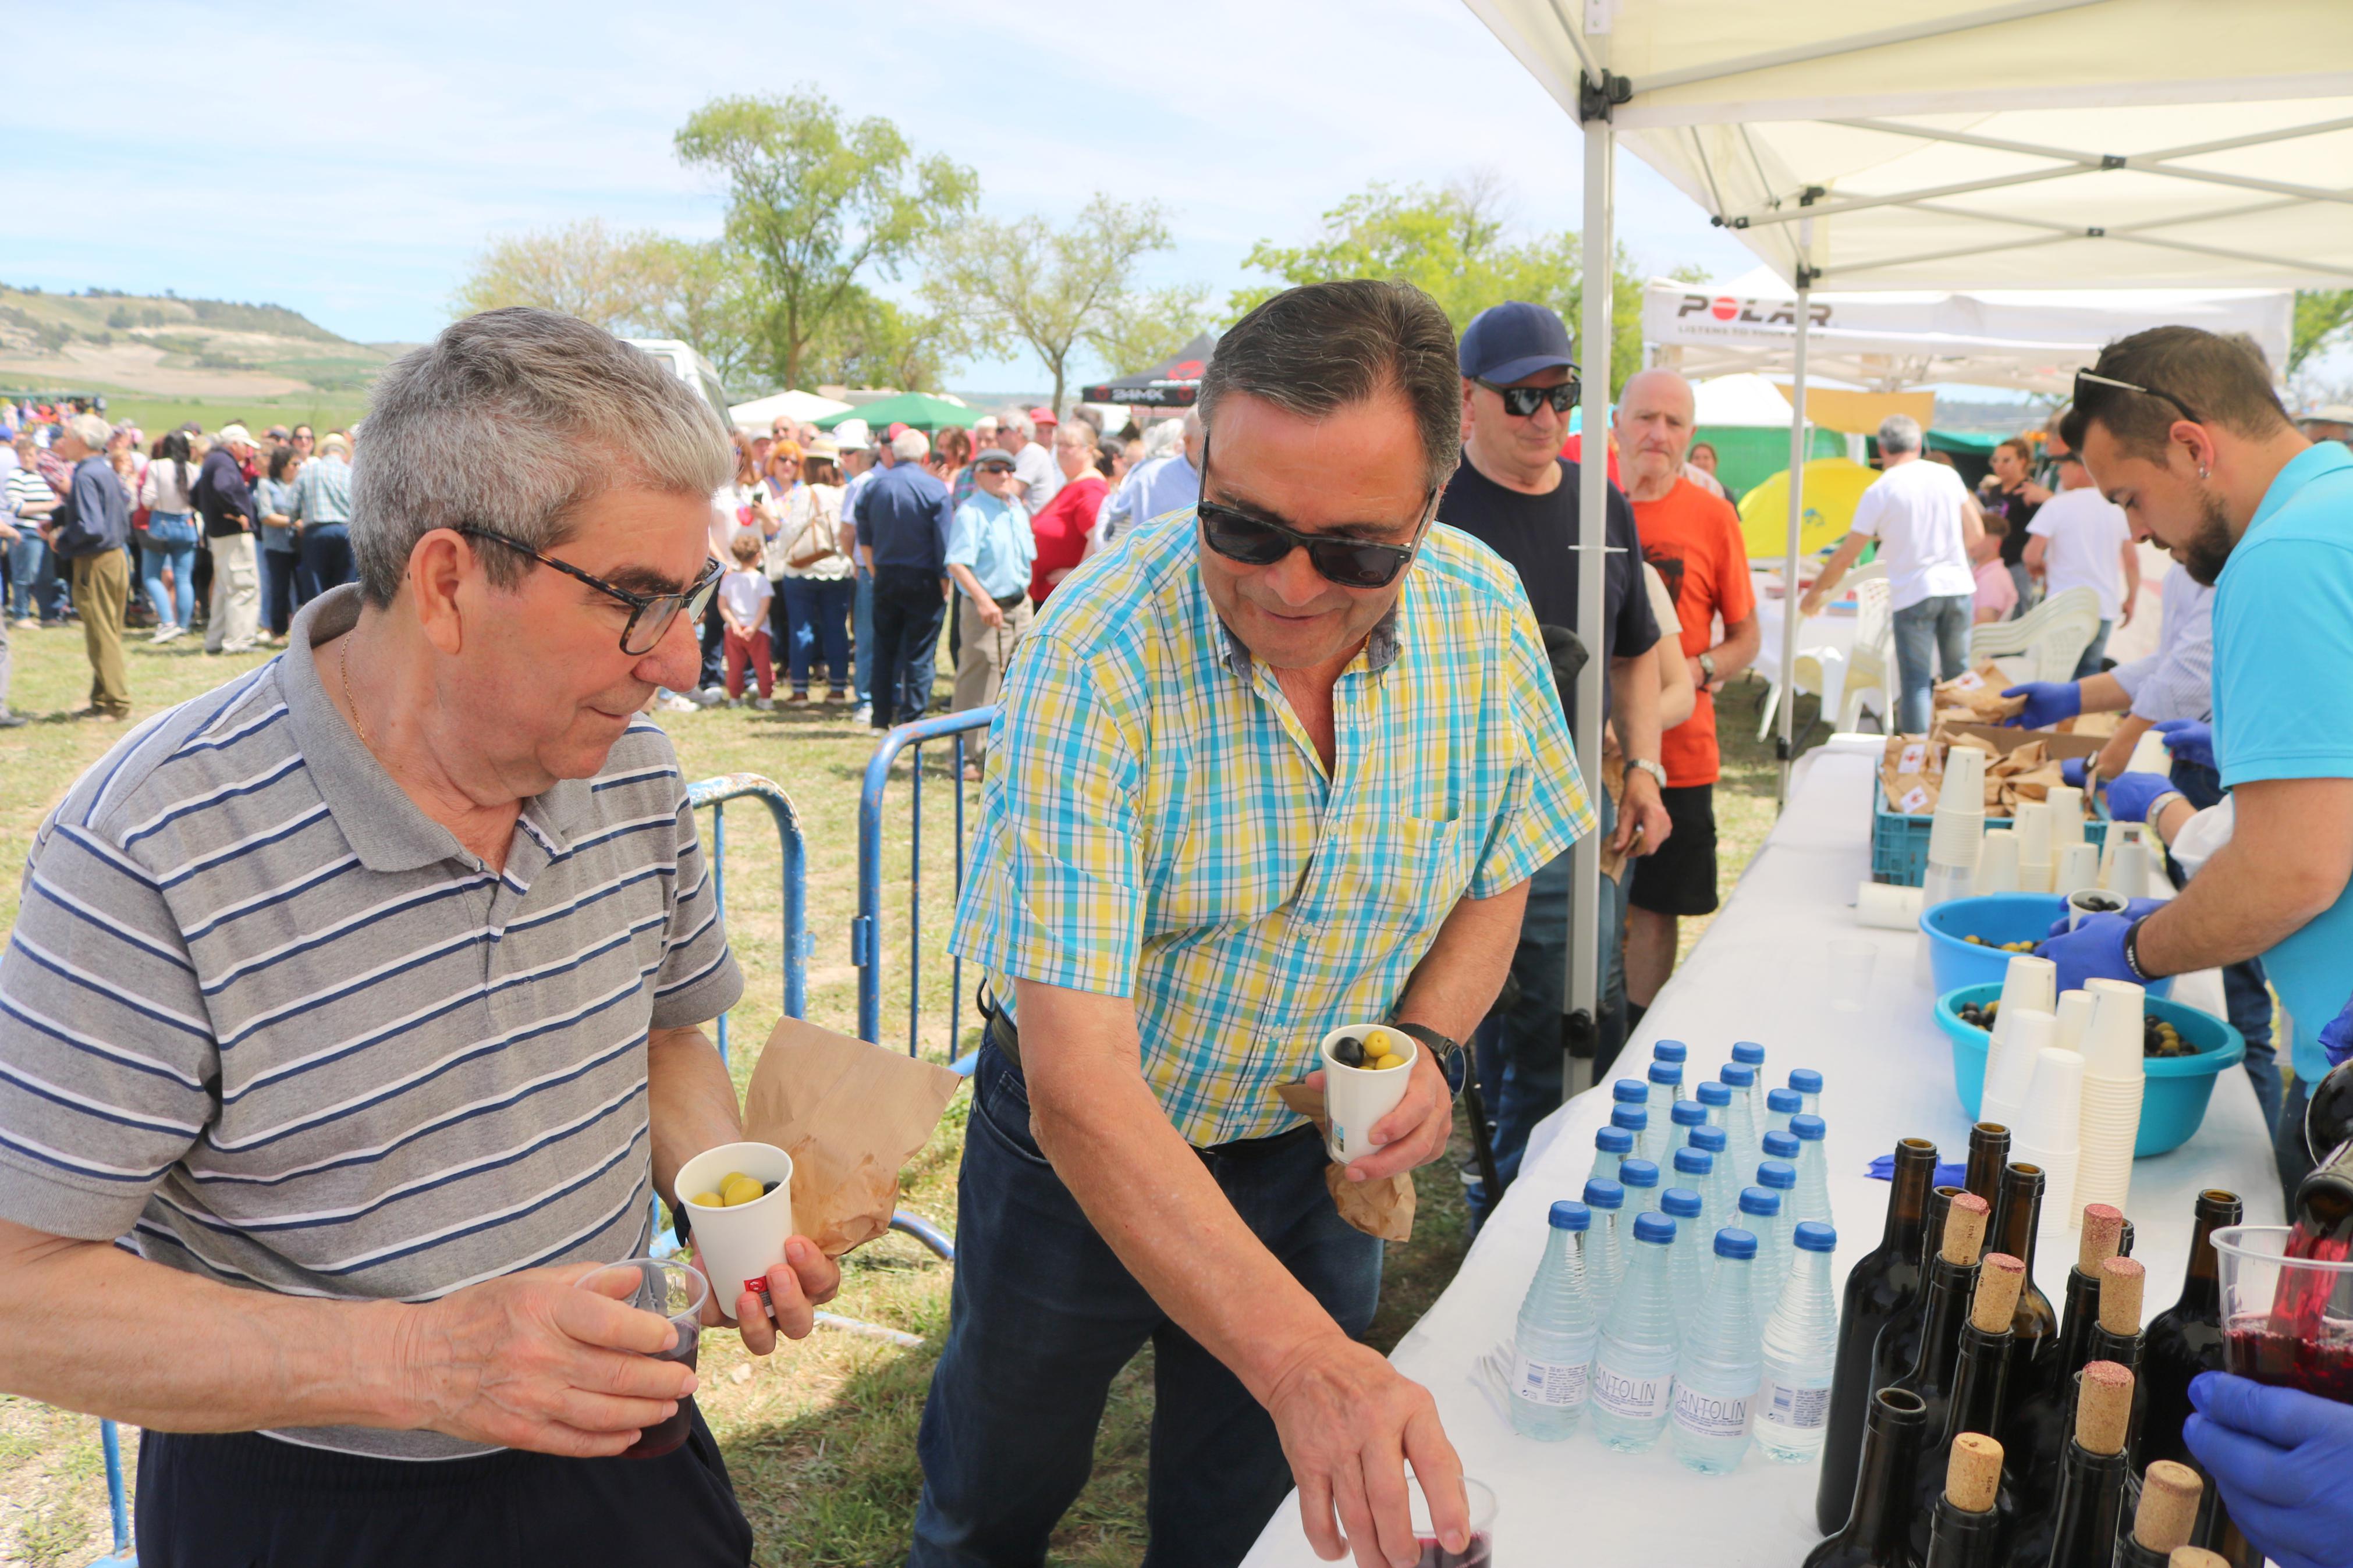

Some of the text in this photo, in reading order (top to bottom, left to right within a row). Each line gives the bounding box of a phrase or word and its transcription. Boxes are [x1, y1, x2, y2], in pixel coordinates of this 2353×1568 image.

[1677, 294, 1832, 326] POLAR
[1112, 389, 1166, 401] 24MX
[1676, 1385, 1747, 1420] SANTOLÍN
